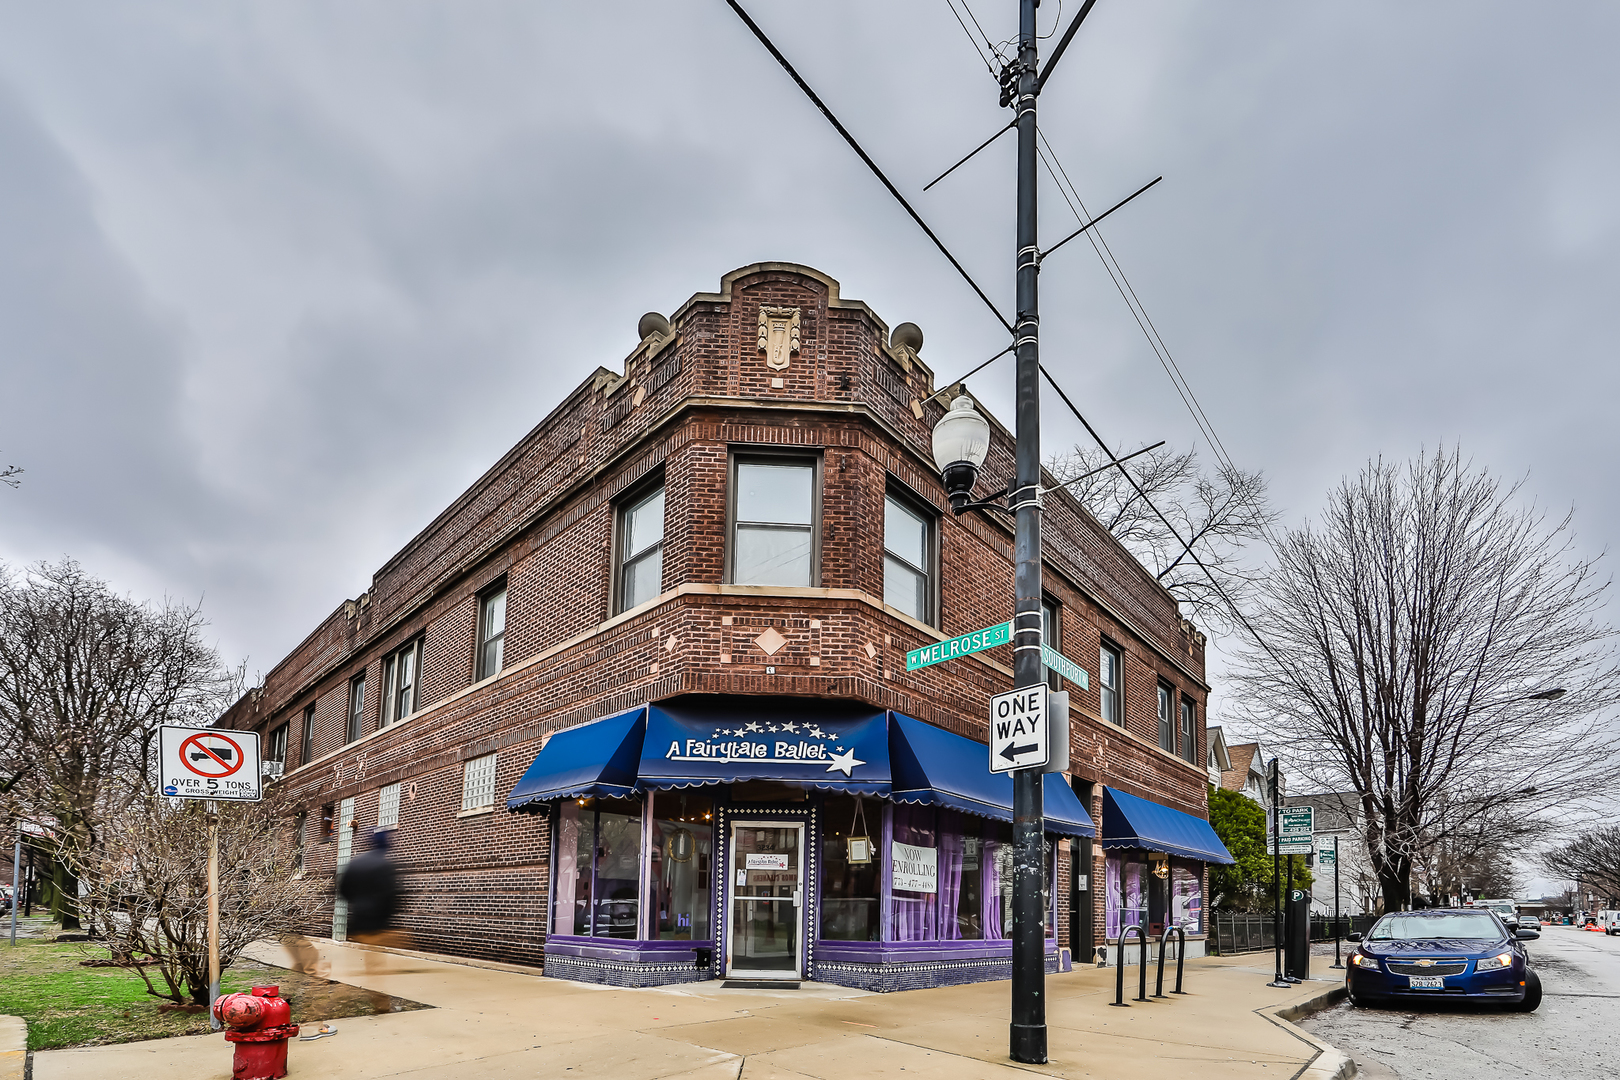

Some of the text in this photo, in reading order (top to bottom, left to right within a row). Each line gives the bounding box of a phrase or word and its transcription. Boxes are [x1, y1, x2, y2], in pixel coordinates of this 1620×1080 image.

[911, 629, 1005, 665] W MELROSE ST
[1044, 648, 1081, 684] SOUTHPORT
[998, 692, 1040, 718] ONE
[996, 714, 1041, 740] WAY
[665, 739, 827, 764] A Fairytale Ballet
[171, 778, 251, 790] OVER 5 TONS
[904, 848, 922, 861] NOW
[892, 860, 935, 877] ENROLLING
[677, 913, 692, 927] hi.
